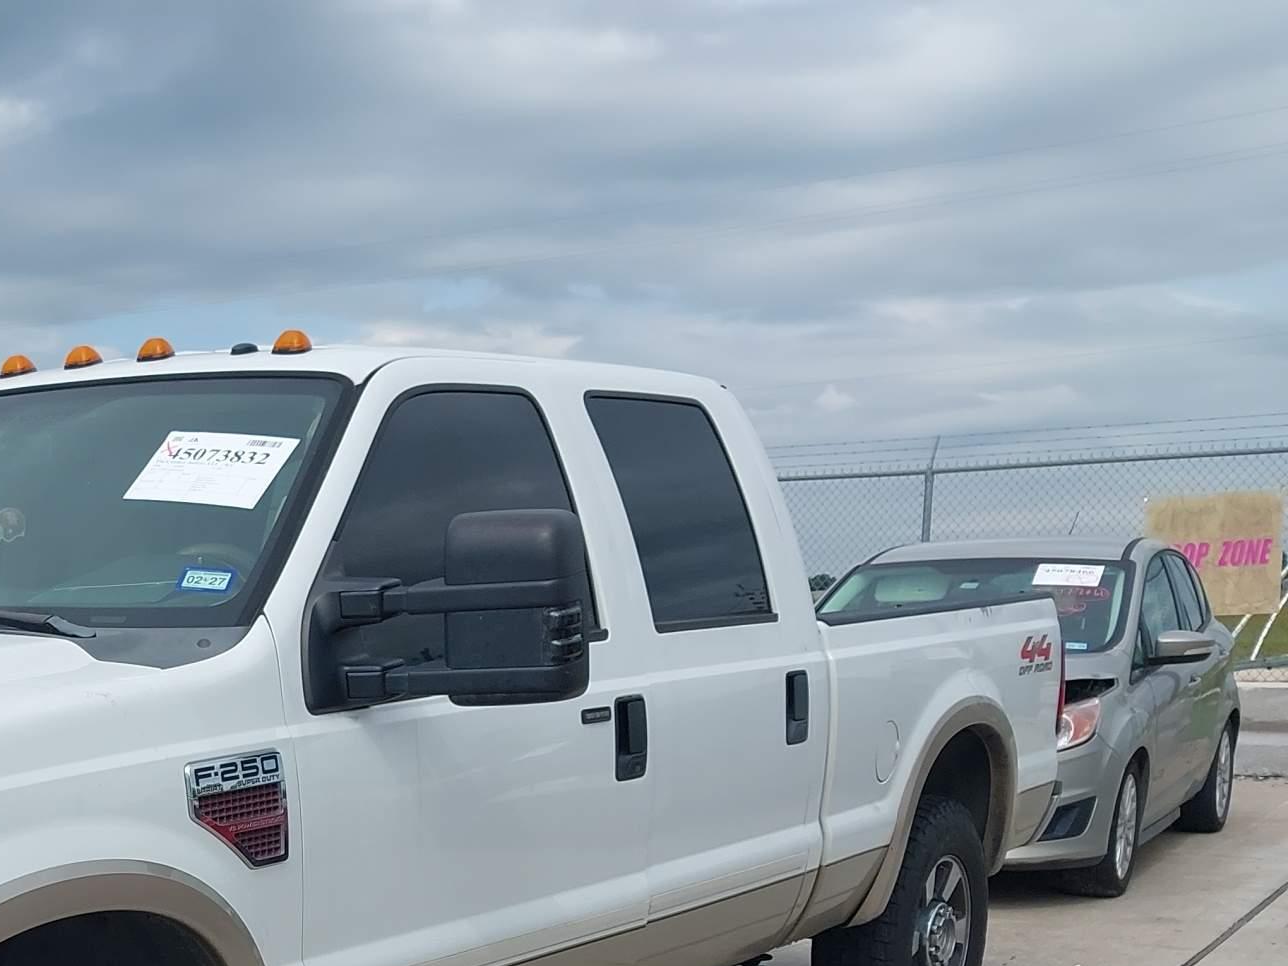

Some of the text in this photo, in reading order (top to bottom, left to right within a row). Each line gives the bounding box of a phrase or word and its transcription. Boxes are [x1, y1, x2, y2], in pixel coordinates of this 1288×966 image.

[169, 447, 271, 465] 45073832
[1217, 538, 1274, 567] ZONE
[194, 754, 280, 787] F-250
[261, 774, 280, 783] DUTY
